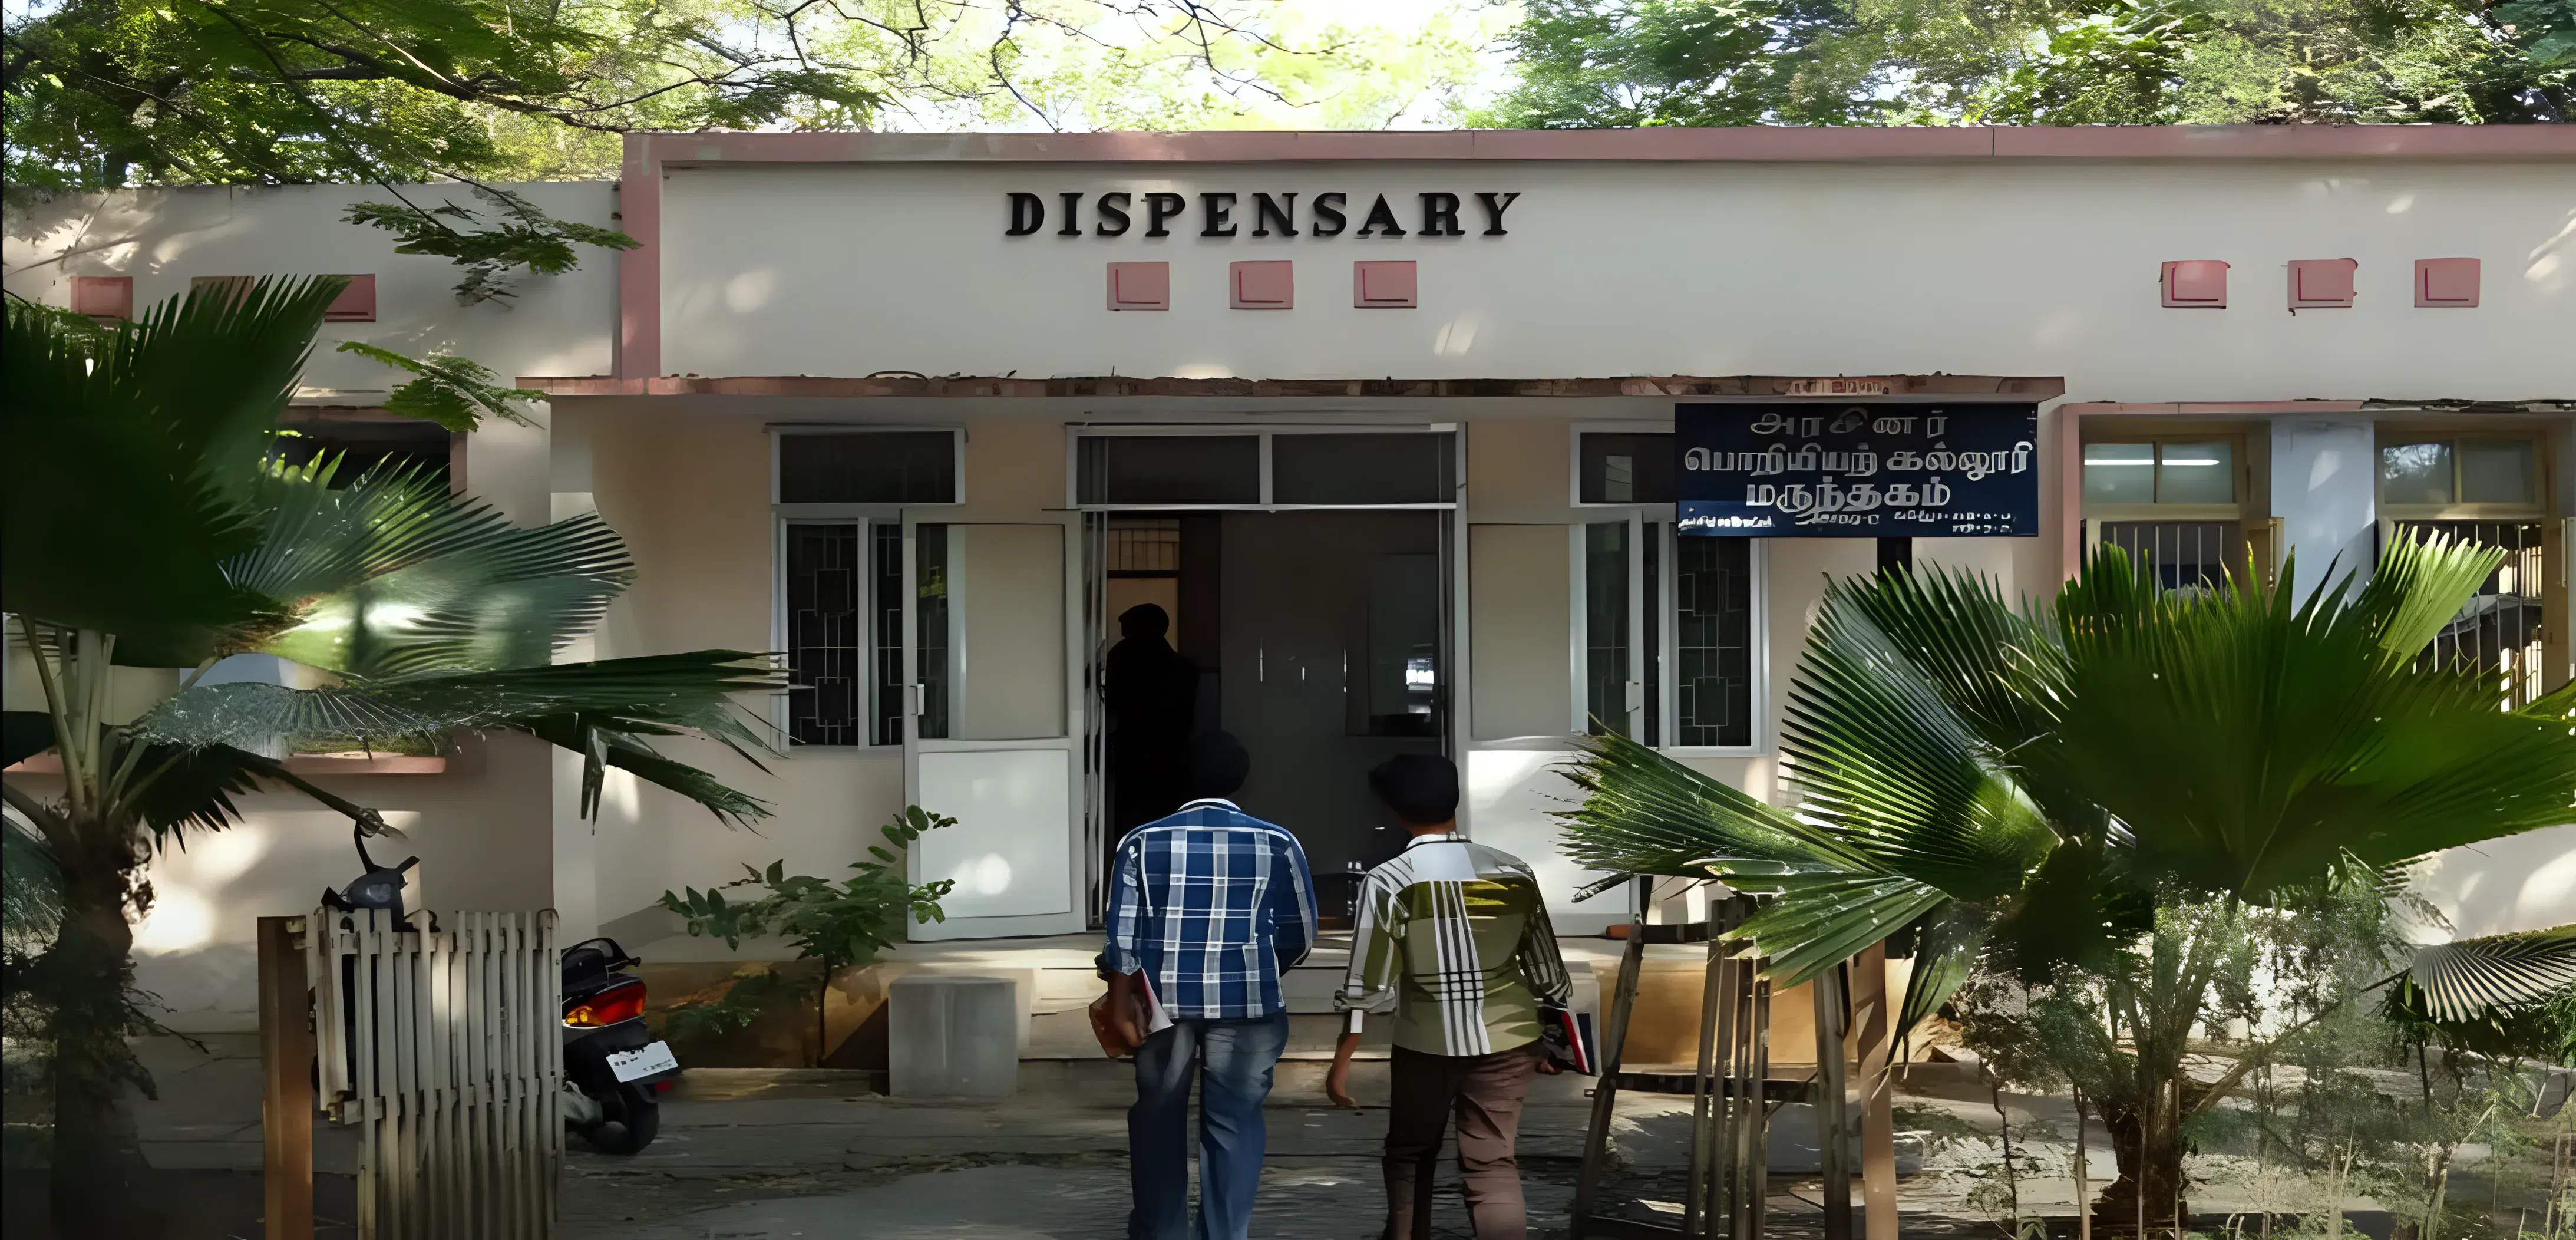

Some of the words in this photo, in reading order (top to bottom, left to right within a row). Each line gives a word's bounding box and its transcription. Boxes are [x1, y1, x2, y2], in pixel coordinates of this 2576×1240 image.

[1005, 192, 1521, 237] DISPENSARY
[1886, 441, 2033, 481] கல்லூரி
[1746, 476, 1951, 516] மருந்தகம்
